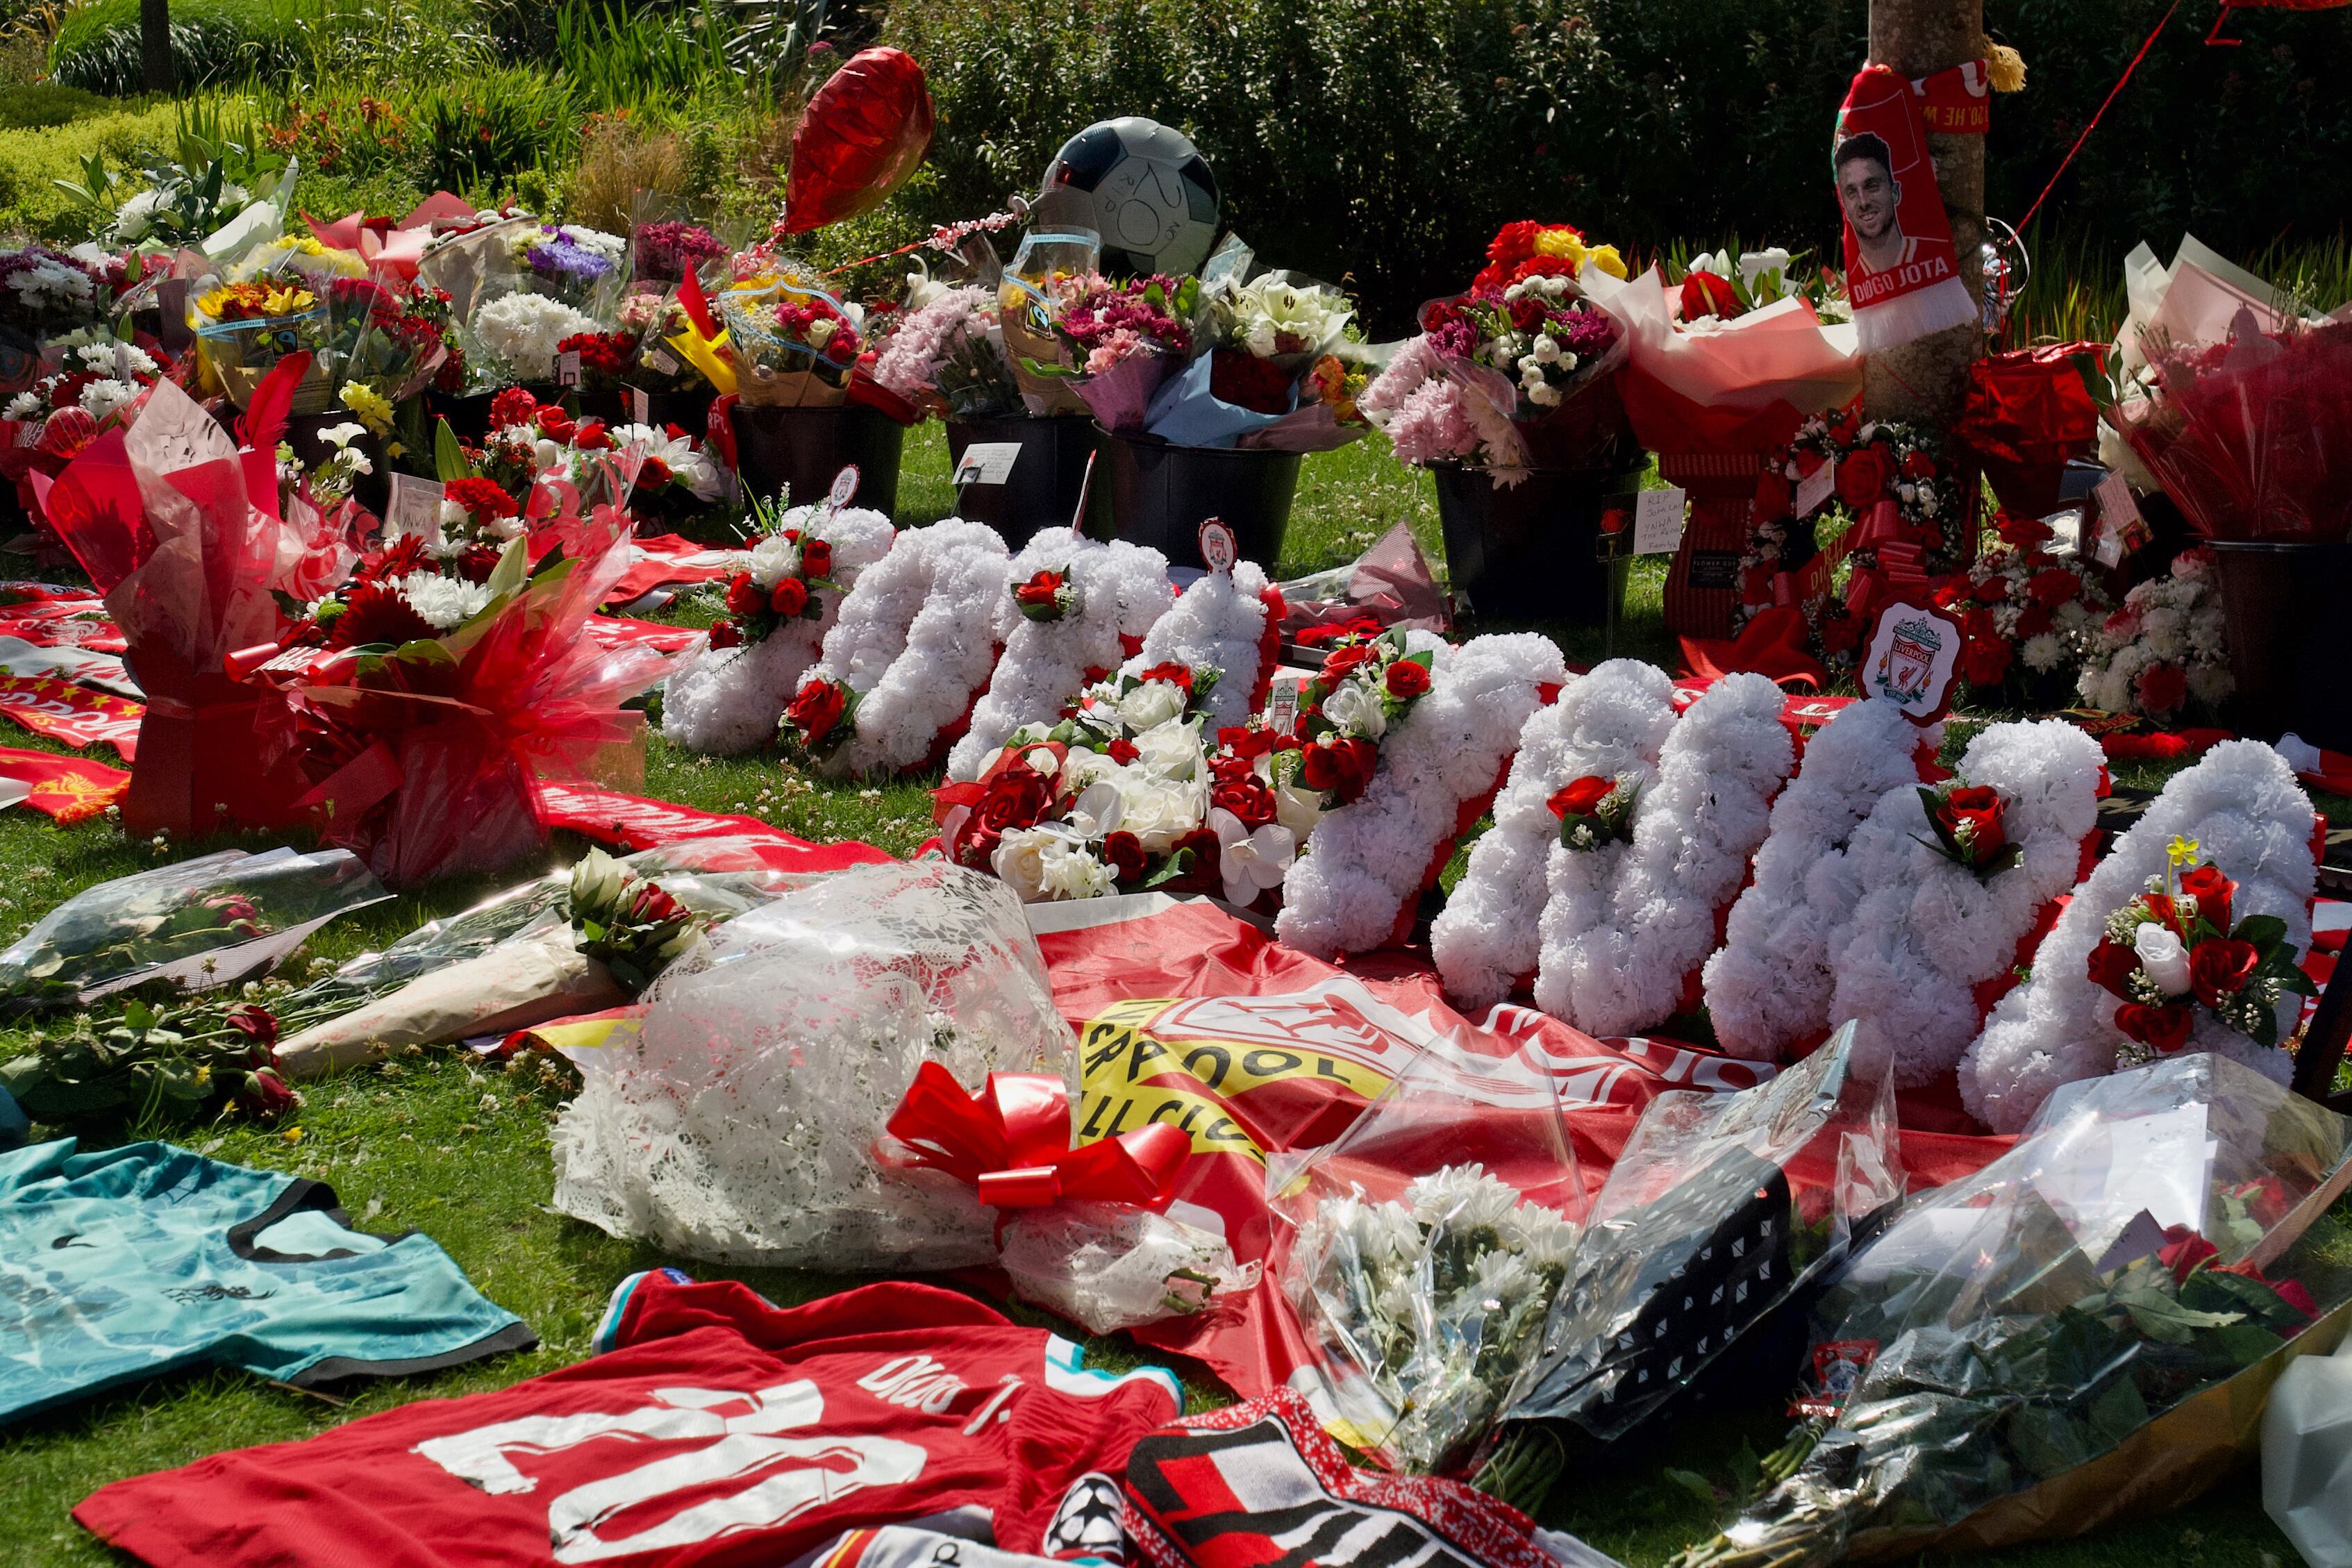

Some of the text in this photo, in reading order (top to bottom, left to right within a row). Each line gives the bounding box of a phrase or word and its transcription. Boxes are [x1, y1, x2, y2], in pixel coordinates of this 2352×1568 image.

[1117, 161, 1181, 247] 20
[1853, 256, 1949, 303] DIOGO JOTA
[13, 433, 37, 450] DIOG
[1648, 492, 1669, 506] RIP
[1645, 517, 1671, 532] YNWA
[1894, 641, 1930, 664] LIVERPOOL
[1147, 1099, 1265, 1164] CLU
[410, 1378, 929, 1566] 20
